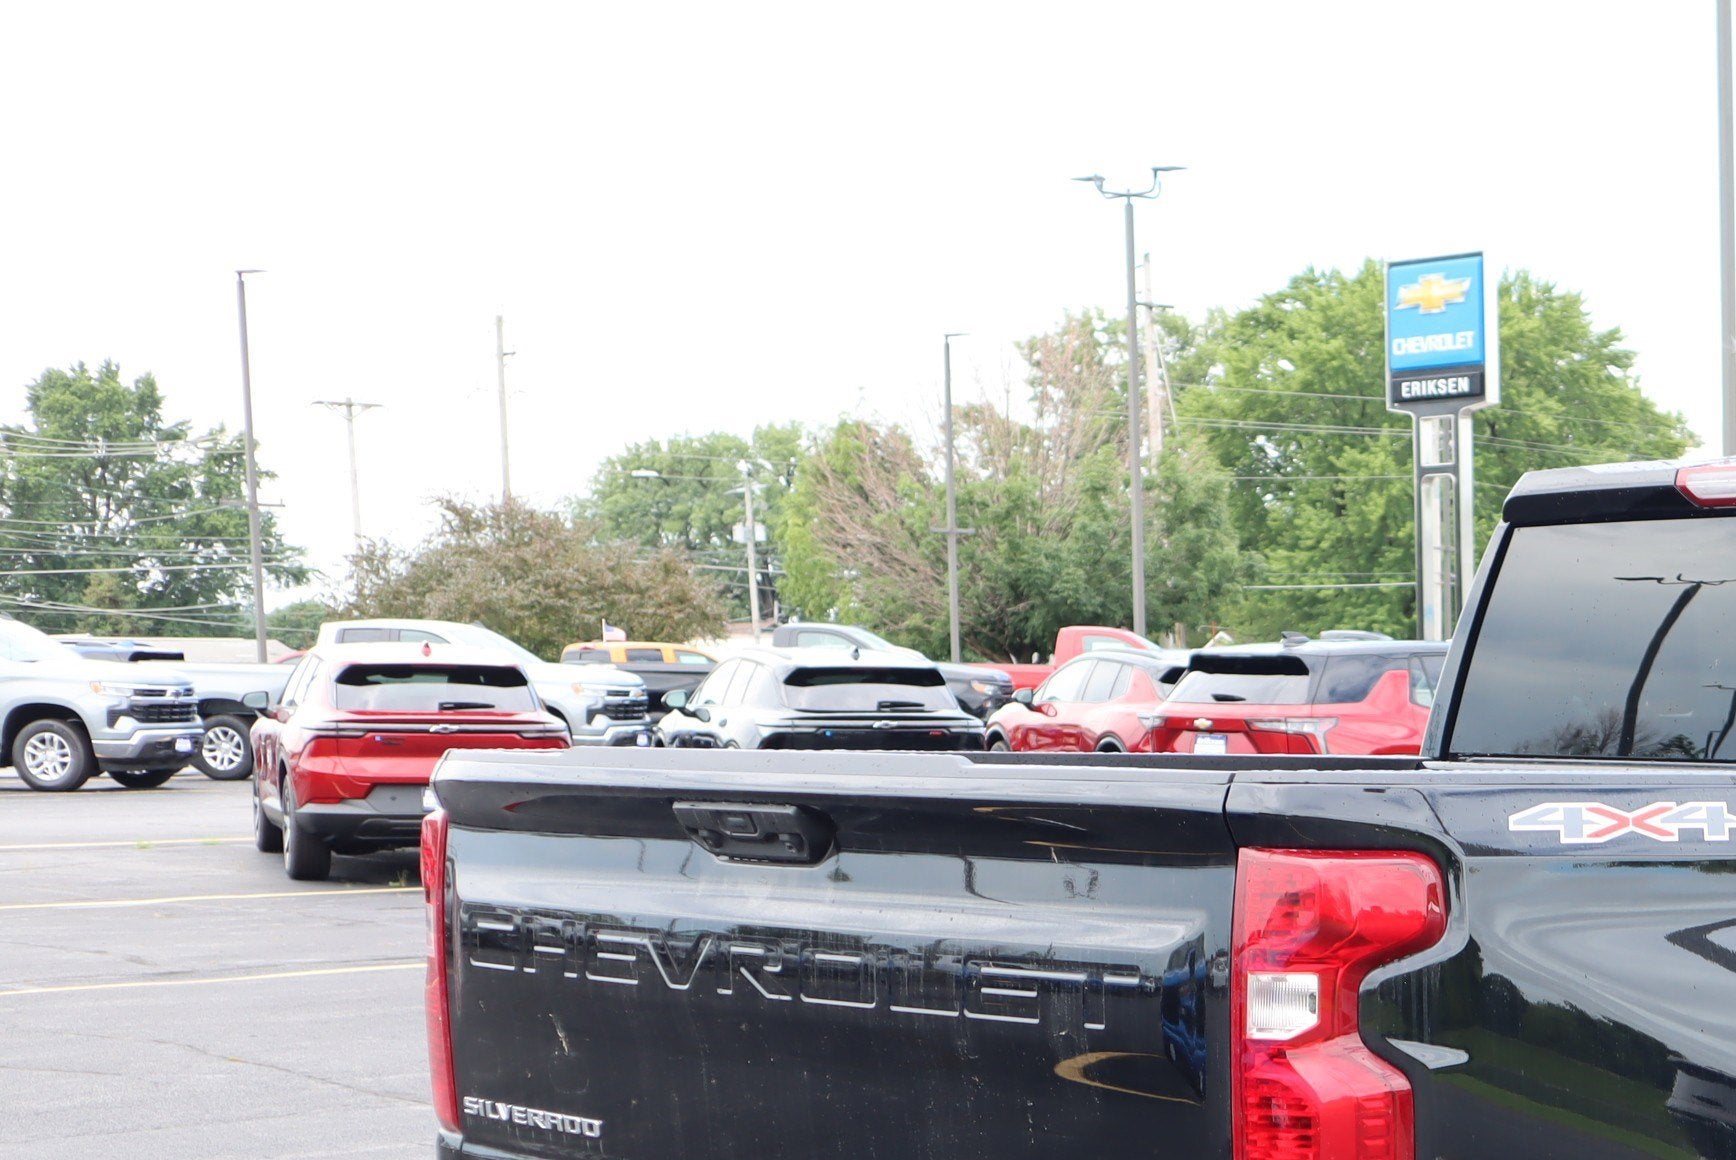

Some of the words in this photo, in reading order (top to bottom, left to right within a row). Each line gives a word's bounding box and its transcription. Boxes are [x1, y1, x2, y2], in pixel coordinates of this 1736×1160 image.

[1392, 331, 1474, 355] CHEVROLET
[1401, 377, 1470, 398] ERIKSEN
[467, 908, 1141, 1030] CHEVROLET
[463, 1096, 603, 1138] SILVERADO
